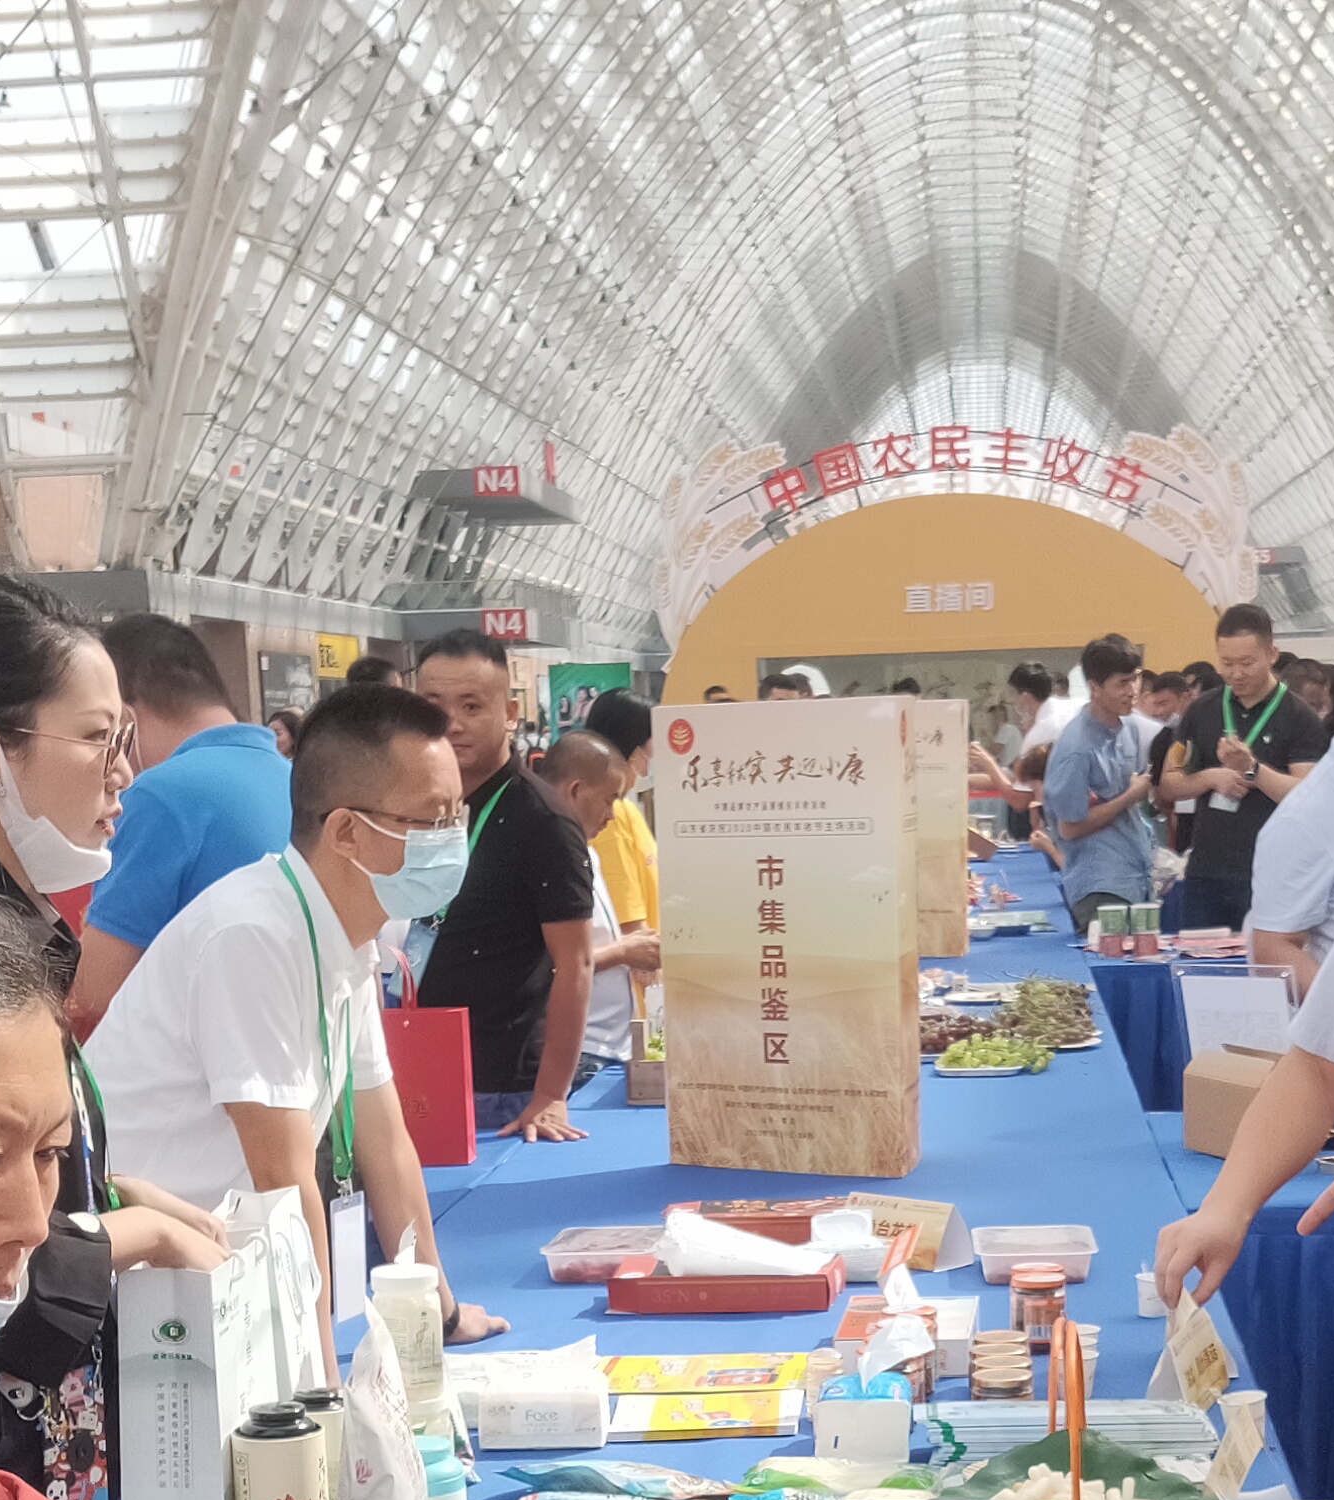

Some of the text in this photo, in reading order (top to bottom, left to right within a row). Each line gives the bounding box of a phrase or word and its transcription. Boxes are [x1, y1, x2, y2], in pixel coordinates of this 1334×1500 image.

[477, 469, 516, 493] N4
[763, 423, 1154, 511] 中国农民丰收节
[903, 581, 995, 613] 直播间
[484, 612, 524, 635] N4
[756, 855, 790, 1064] 市集品鉴区
